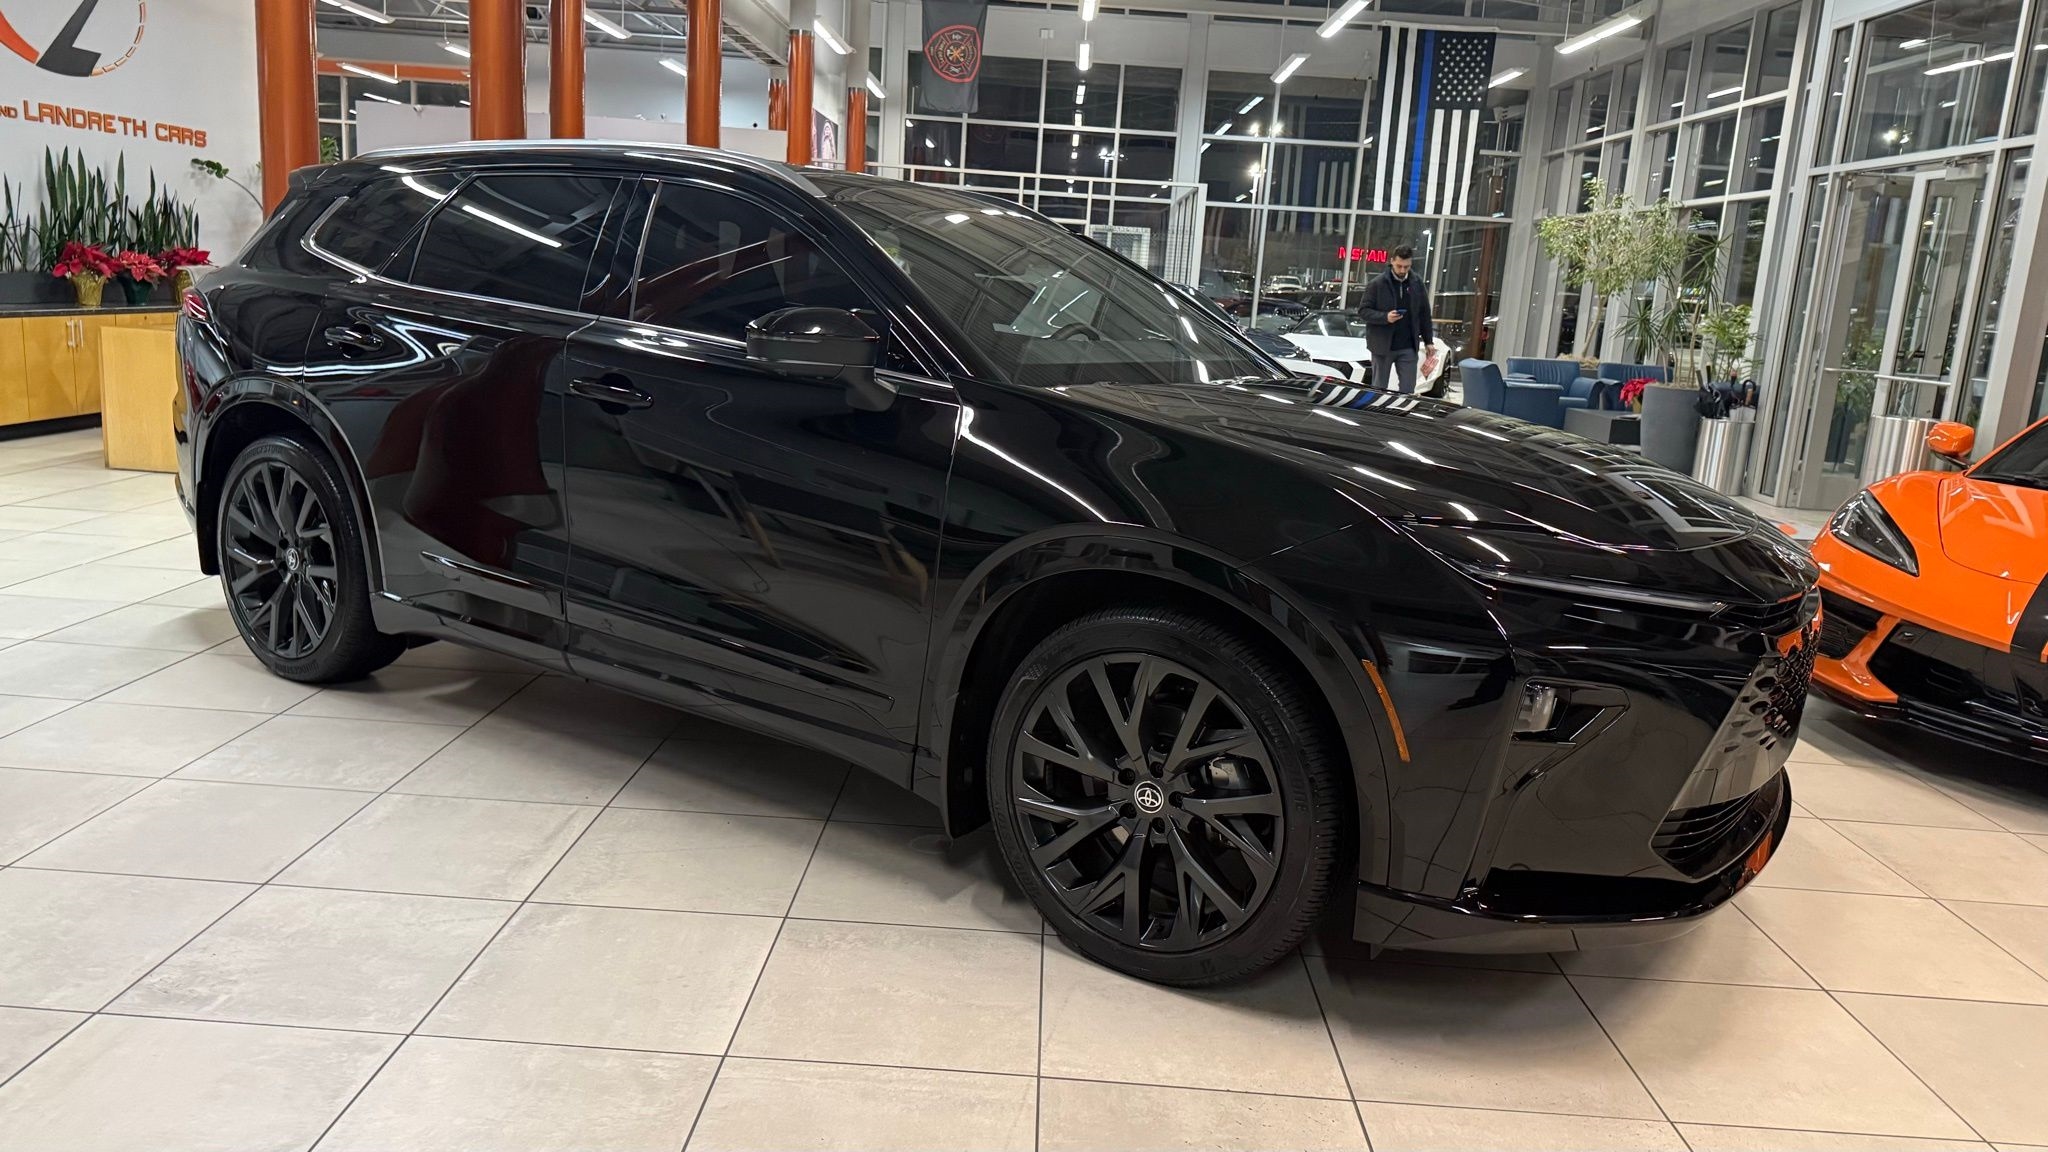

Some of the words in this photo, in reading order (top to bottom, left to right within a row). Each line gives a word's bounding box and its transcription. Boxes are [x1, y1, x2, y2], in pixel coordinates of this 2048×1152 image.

[23, 100, 148, 138] LANDRETH
[155, 122, 208, 149] CARS
[1338, 246, 1387, 263] NSAN
